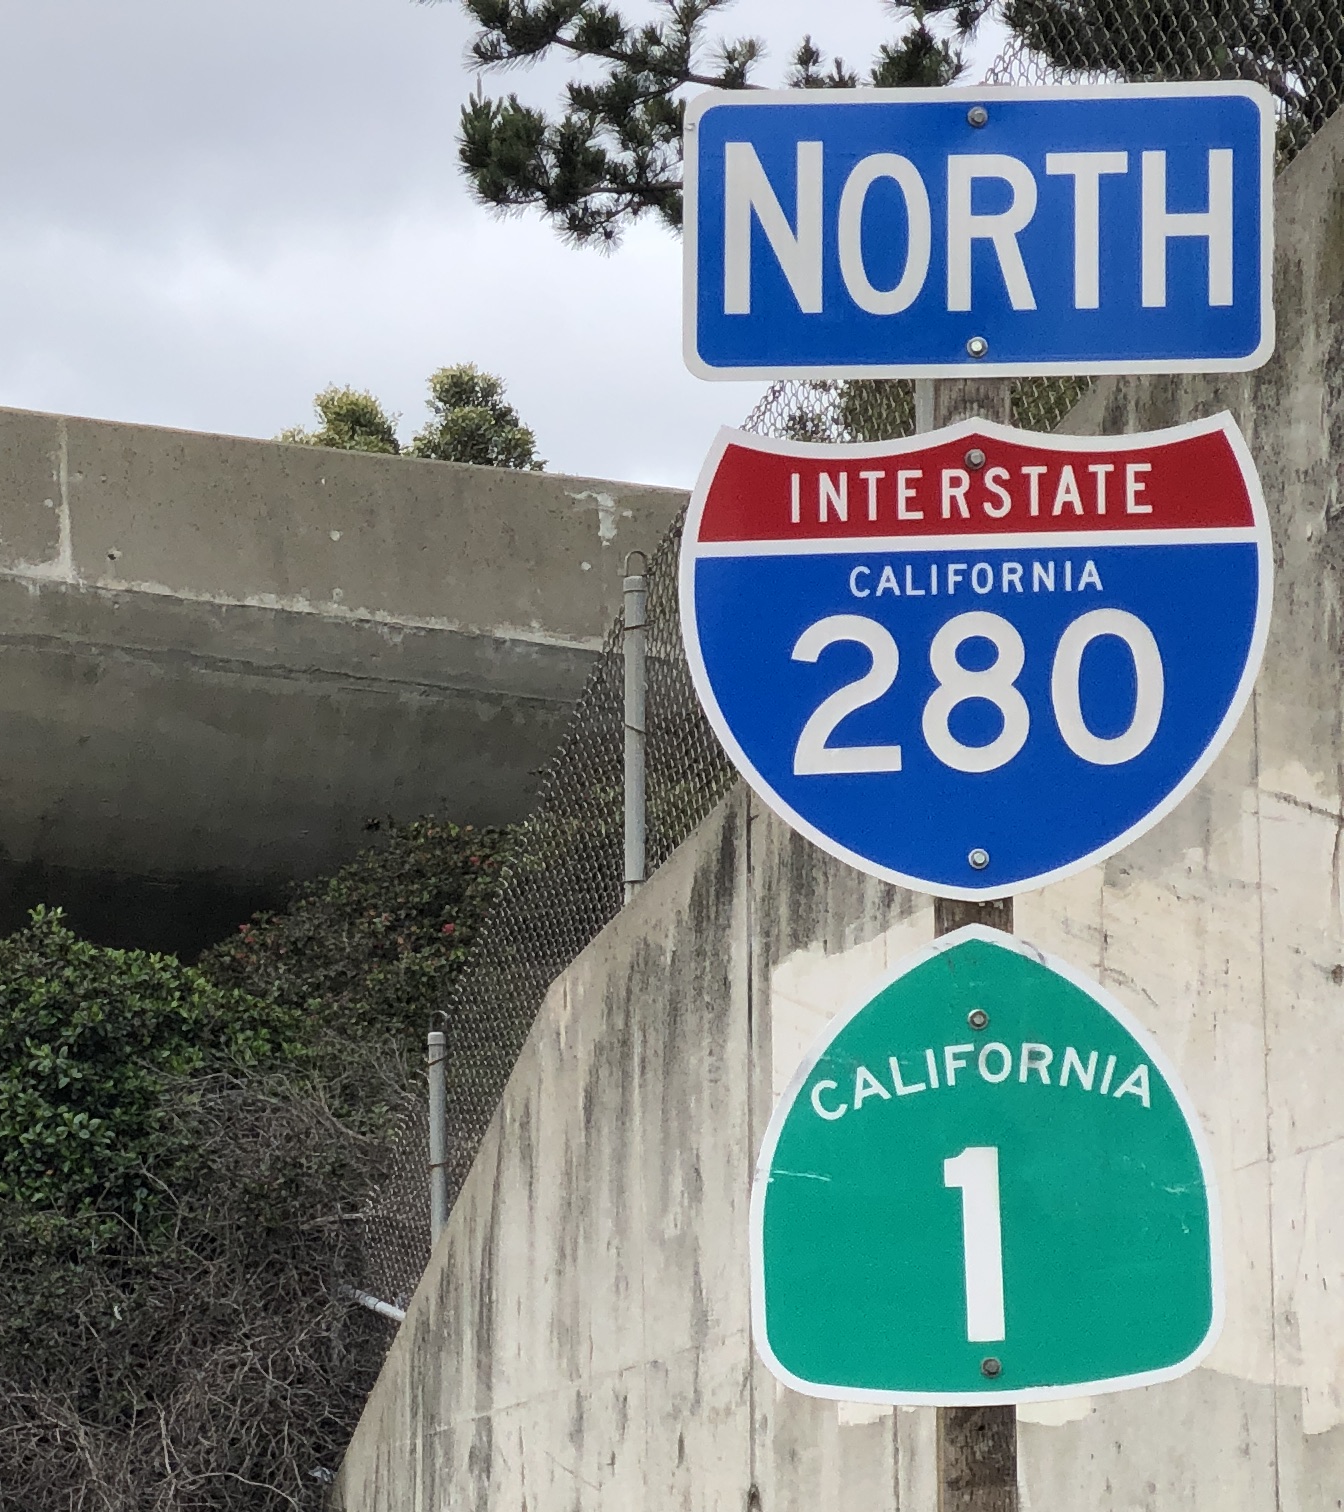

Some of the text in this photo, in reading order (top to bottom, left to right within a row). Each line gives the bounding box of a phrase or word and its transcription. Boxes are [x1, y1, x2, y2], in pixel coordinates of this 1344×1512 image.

[724, 141, 1234, 316] NORTH
[790, 462, 1154, 524] INTERSTATE
[849, 560, 1103, 598] CALIFORNIA
[791, 608, 1165, 776] 280
[810, 1042, 1152, 1121] CALIFORNIA
[943, 1146, 1006, 1343] 1
